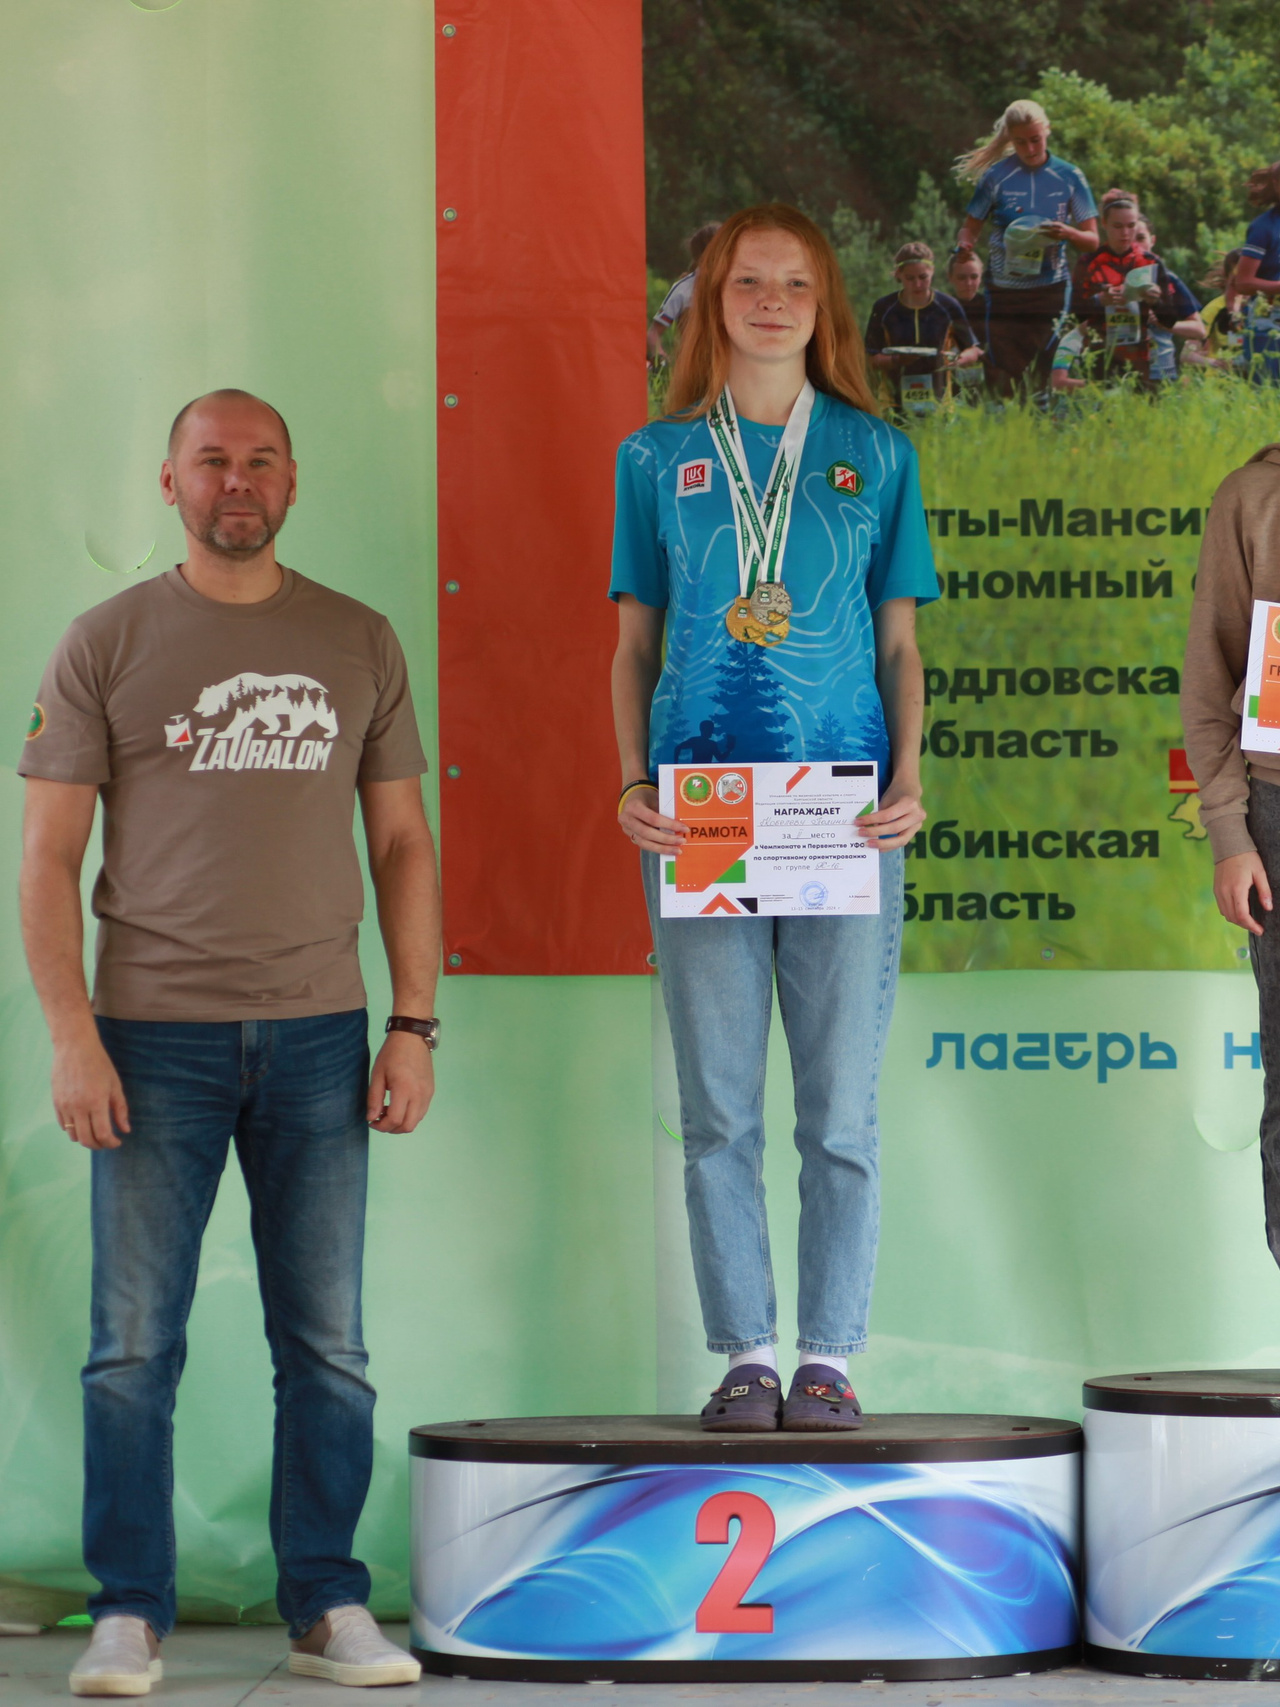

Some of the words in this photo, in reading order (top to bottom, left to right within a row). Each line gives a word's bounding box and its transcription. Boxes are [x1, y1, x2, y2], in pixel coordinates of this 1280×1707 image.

[743, 493, 757, 523] КУРГАНСКАЯ
[753, 523, 765, 548] ОБЛАСТЬ
[773, 518, 783, 550] КУРГАНСКАЯ
[925, 498, 1213, 537] ты-Манси
[938, 559, 1173, 599] ономный
[919, 720, 1119, 759] бласть
[774, 807, 841, 816] НАГРАЖДАЕТ
[785, 864, 811, 872] группе
[926, 1031, 1178, 1084] лагерь
[695, 1489, 776, 1634] 2
